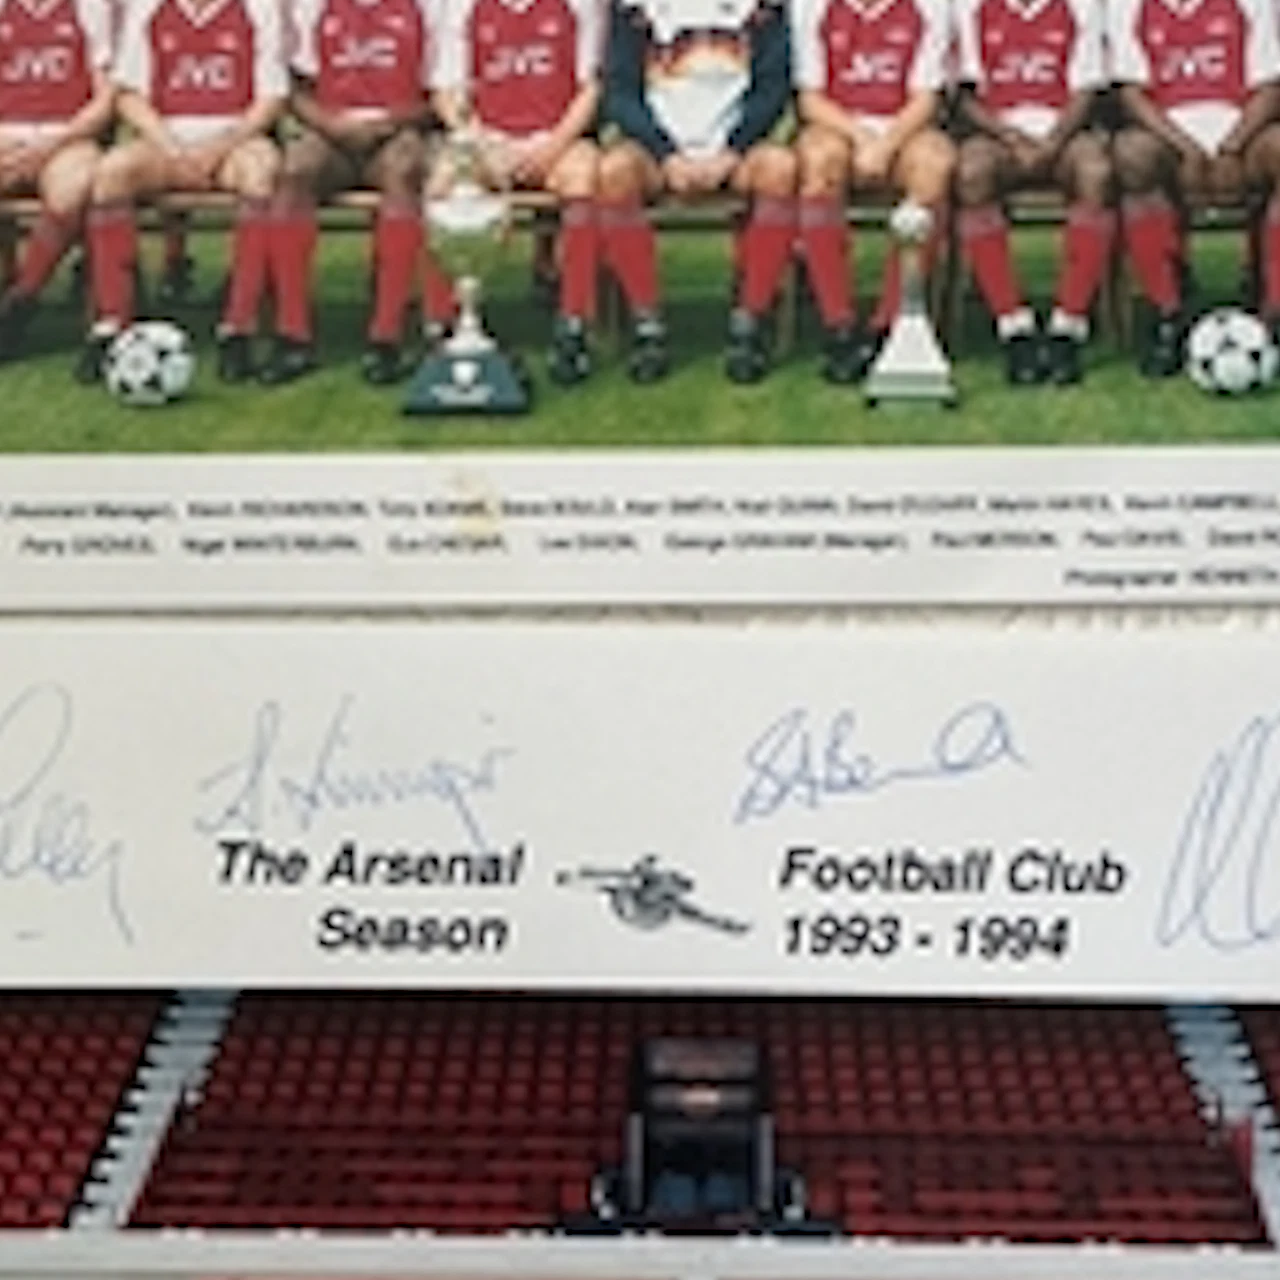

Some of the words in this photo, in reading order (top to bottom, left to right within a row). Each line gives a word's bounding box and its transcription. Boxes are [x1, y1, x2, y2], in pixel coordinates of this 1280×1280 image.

[0, 46, 74, 83] JVC
[170, 53, 236, 90] JVC
[839, 51, 904, 85] JVC
[991, 52, 1060, 84] JVC
[1159, 44, 1227, 80] JVC
[218, 840, 308, 885] The
[325, 841, 525, 886] Arsenal
[779, 848, 993, 892] Football
[1010, 848, 1125, 893] Club
[318, 908, 509, 952] Season
[786, 916, 901, 957] 1993
[955, 916, 1070, 960] 1994
